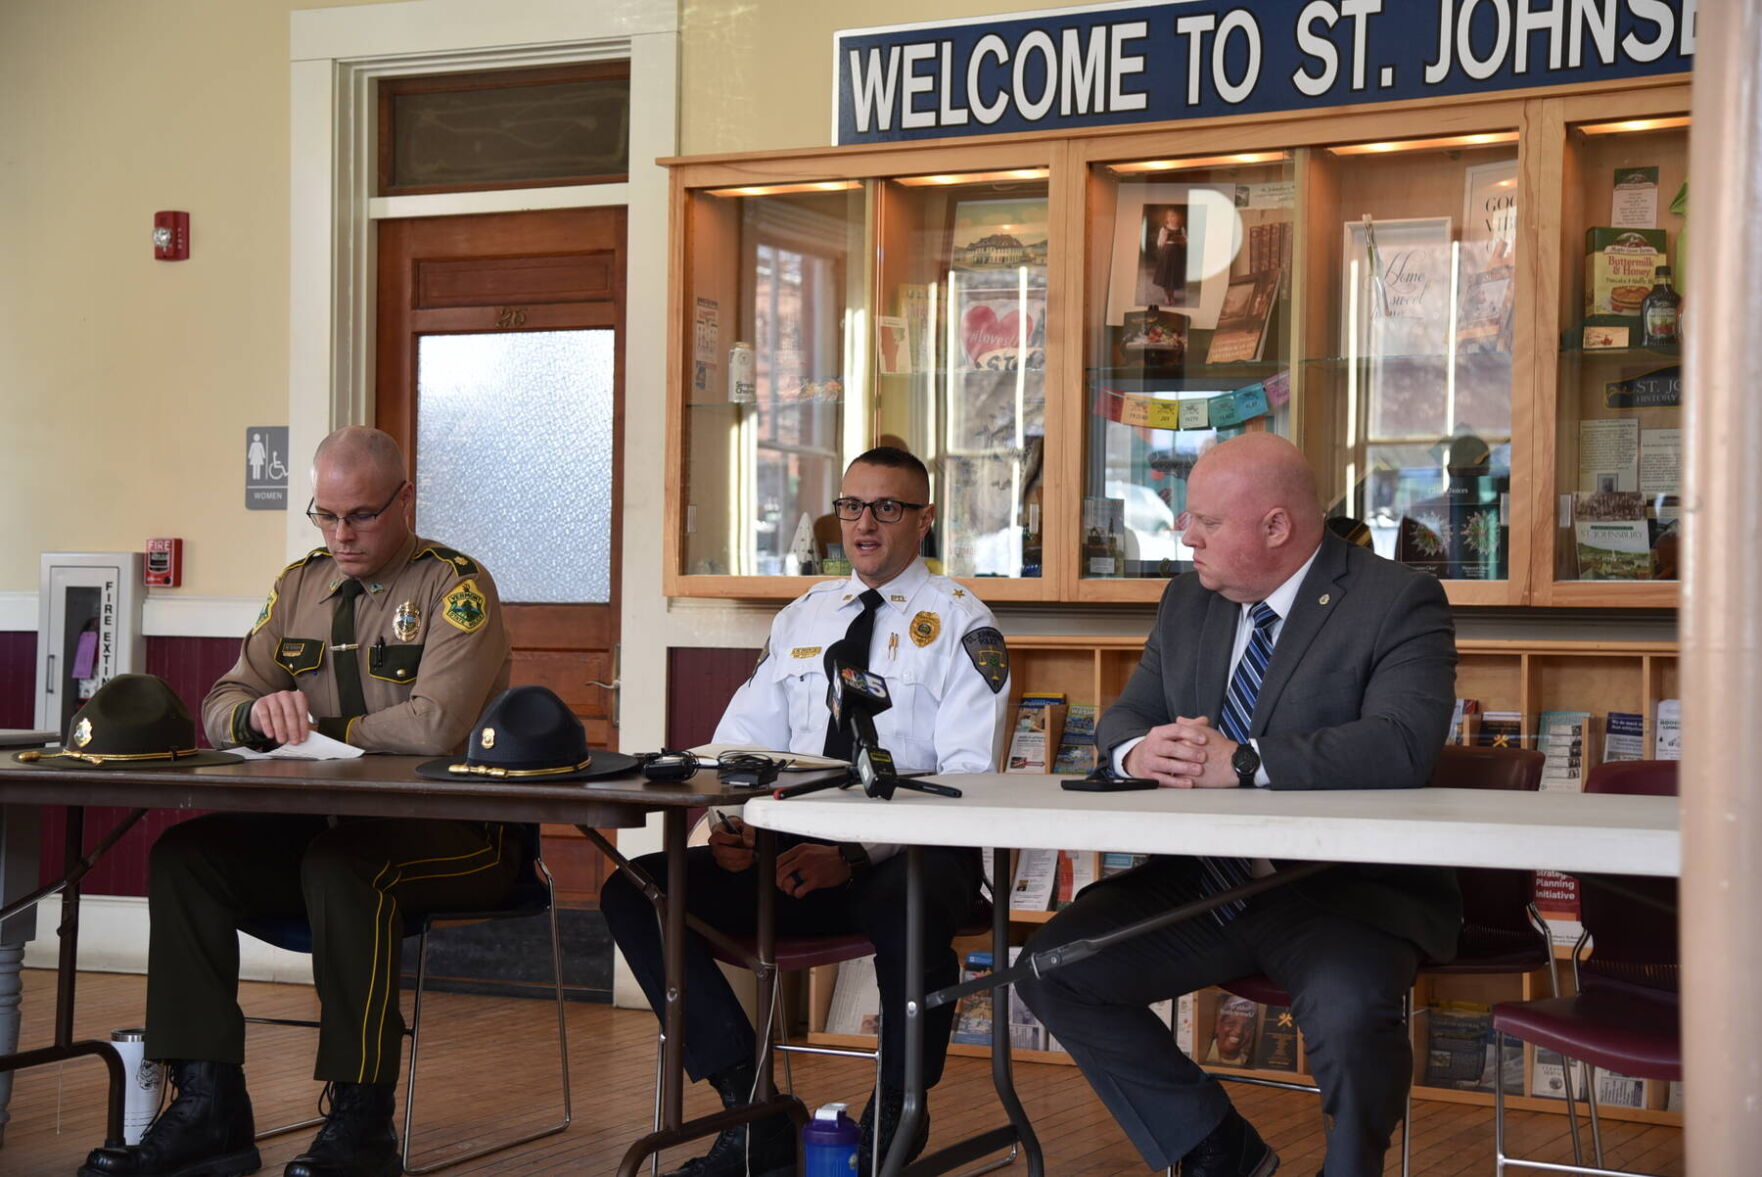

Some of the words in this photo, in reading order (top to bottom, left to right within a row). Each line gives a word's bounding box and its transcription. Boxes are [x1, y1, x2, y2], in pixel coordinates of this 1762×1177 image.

[849, 21, 1148, 133] WELCOME
[1177, 9, 1262, 106] TO
[1292, 0, 1394, 96] ST.
[1608, 255, 1654, 267] Buttermilk
[1623, 265, 1651, 278] Honey
[254, 492, 282, 500] WOMEN
[149, 540, 171, 551] FIRE
[103, 581, 113, 626] FIRE
[864, 673, 887, 698] 5
[1536, 879, 1575, 891] Planning
[1535, 890, 1576, 900] Initiative
